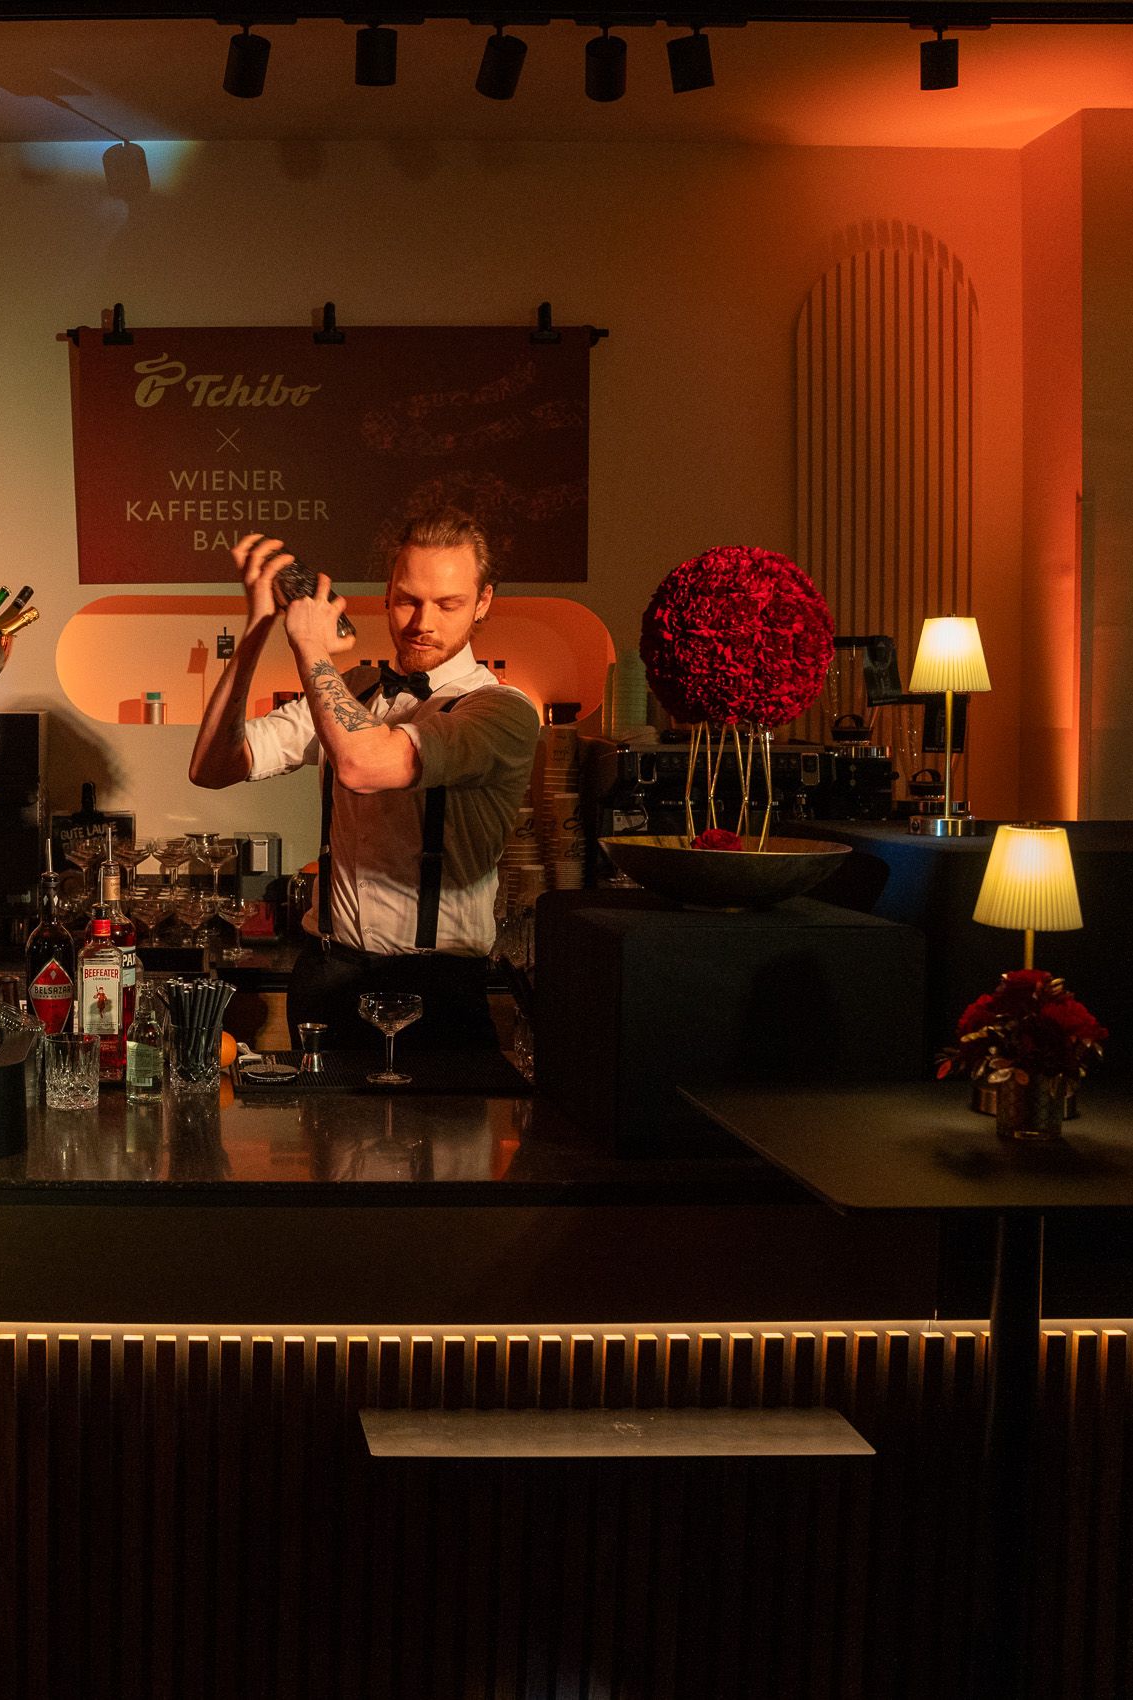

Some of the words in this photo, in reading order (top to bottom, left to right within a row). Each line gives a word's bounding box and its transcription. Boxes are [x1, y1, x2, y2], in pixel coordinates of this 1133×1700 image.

[185, 374, 322, 408] Tchibo
[169, 470, 285, 491] WIENER
[125, 500, 330, 522] KAFFEESIEDER
[193, 529, 255, 551] BAL
[84, 968, 119, 979] BEEFEATER
[34, 985, 71, 995] BELSAZAR
